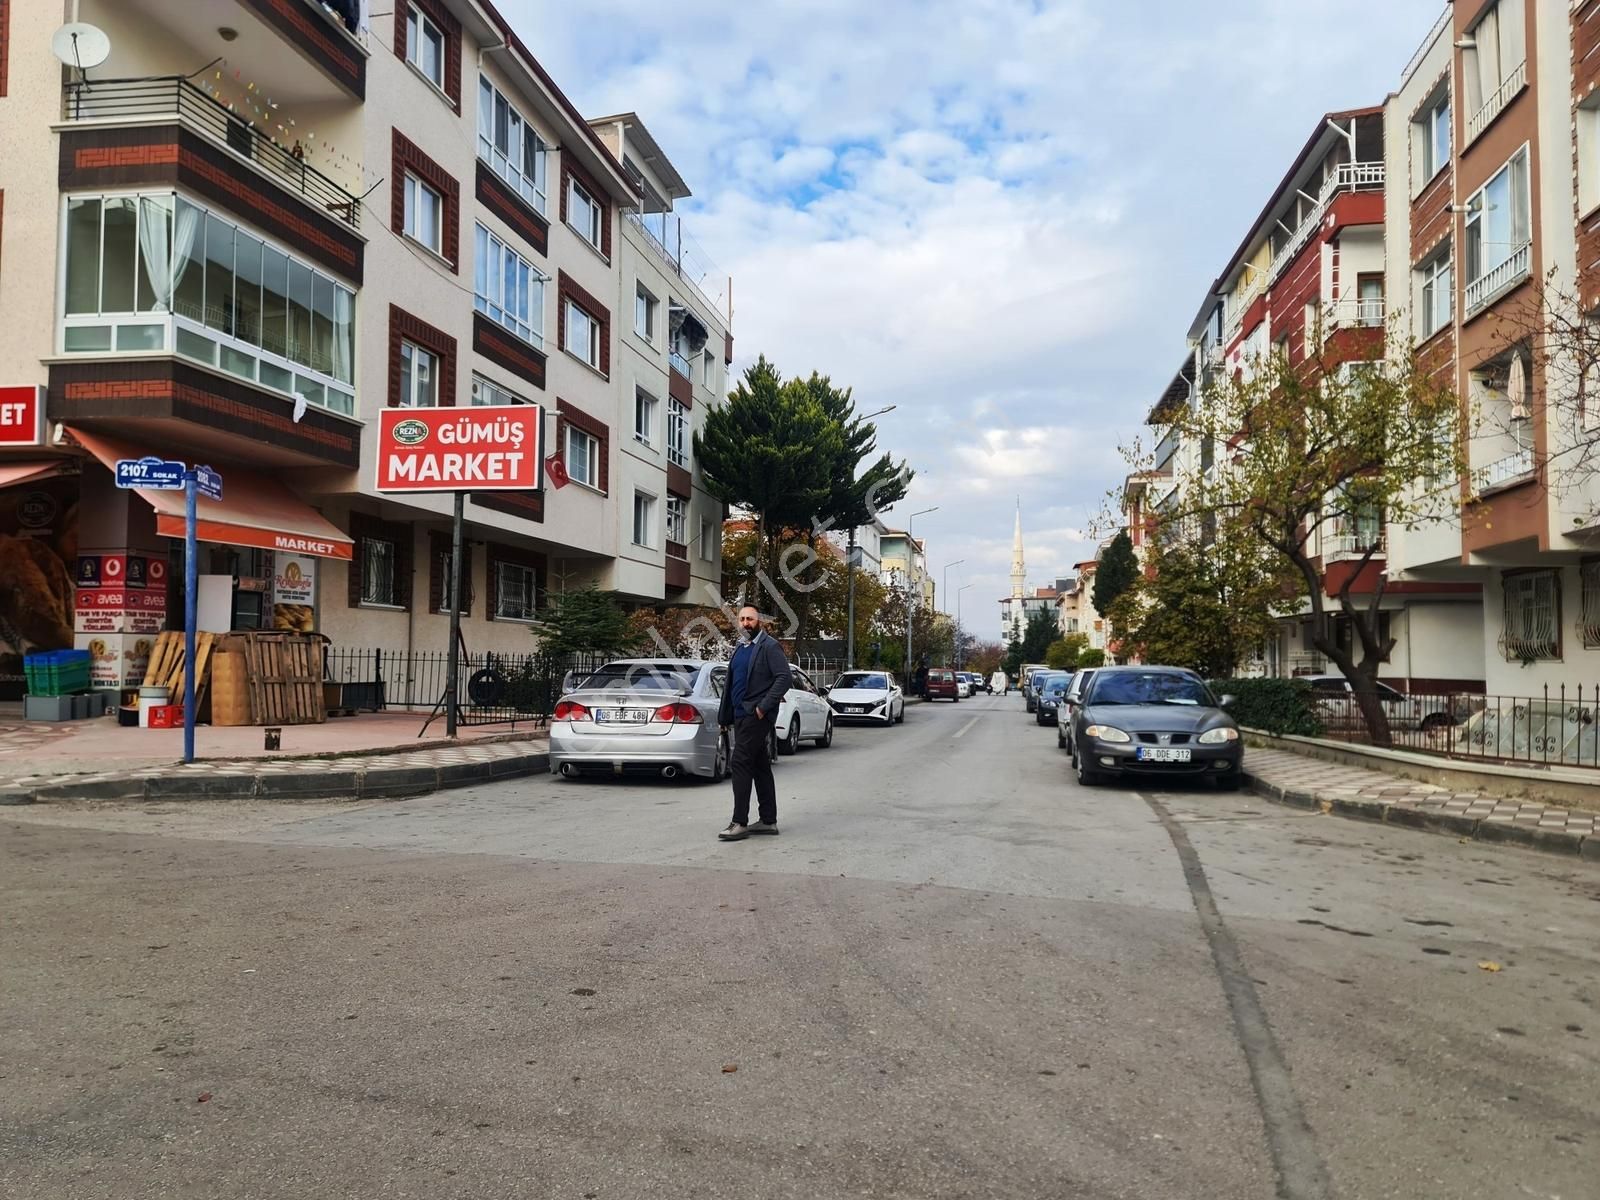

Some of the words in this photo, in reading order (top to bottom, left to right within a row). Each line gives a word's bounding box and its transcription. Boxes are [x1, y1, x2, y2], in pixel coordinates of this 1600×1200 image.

[437, 416, 525, 449] GÜMÜŞ
[120, 464, 149, 477] 2107.
[388, 452, 524, 482] MARKET
[275, 536, 335, 554] MARKET
[263, 549, 273, 629] NDURMA
[97, 594, 123, 605] avea
[143, 595, 166, 606] avea
[1142, 749, 1152, 757] 06
[1156, 749, 1170, 758] DDE
[1175, 750, 1190, 759] 312
